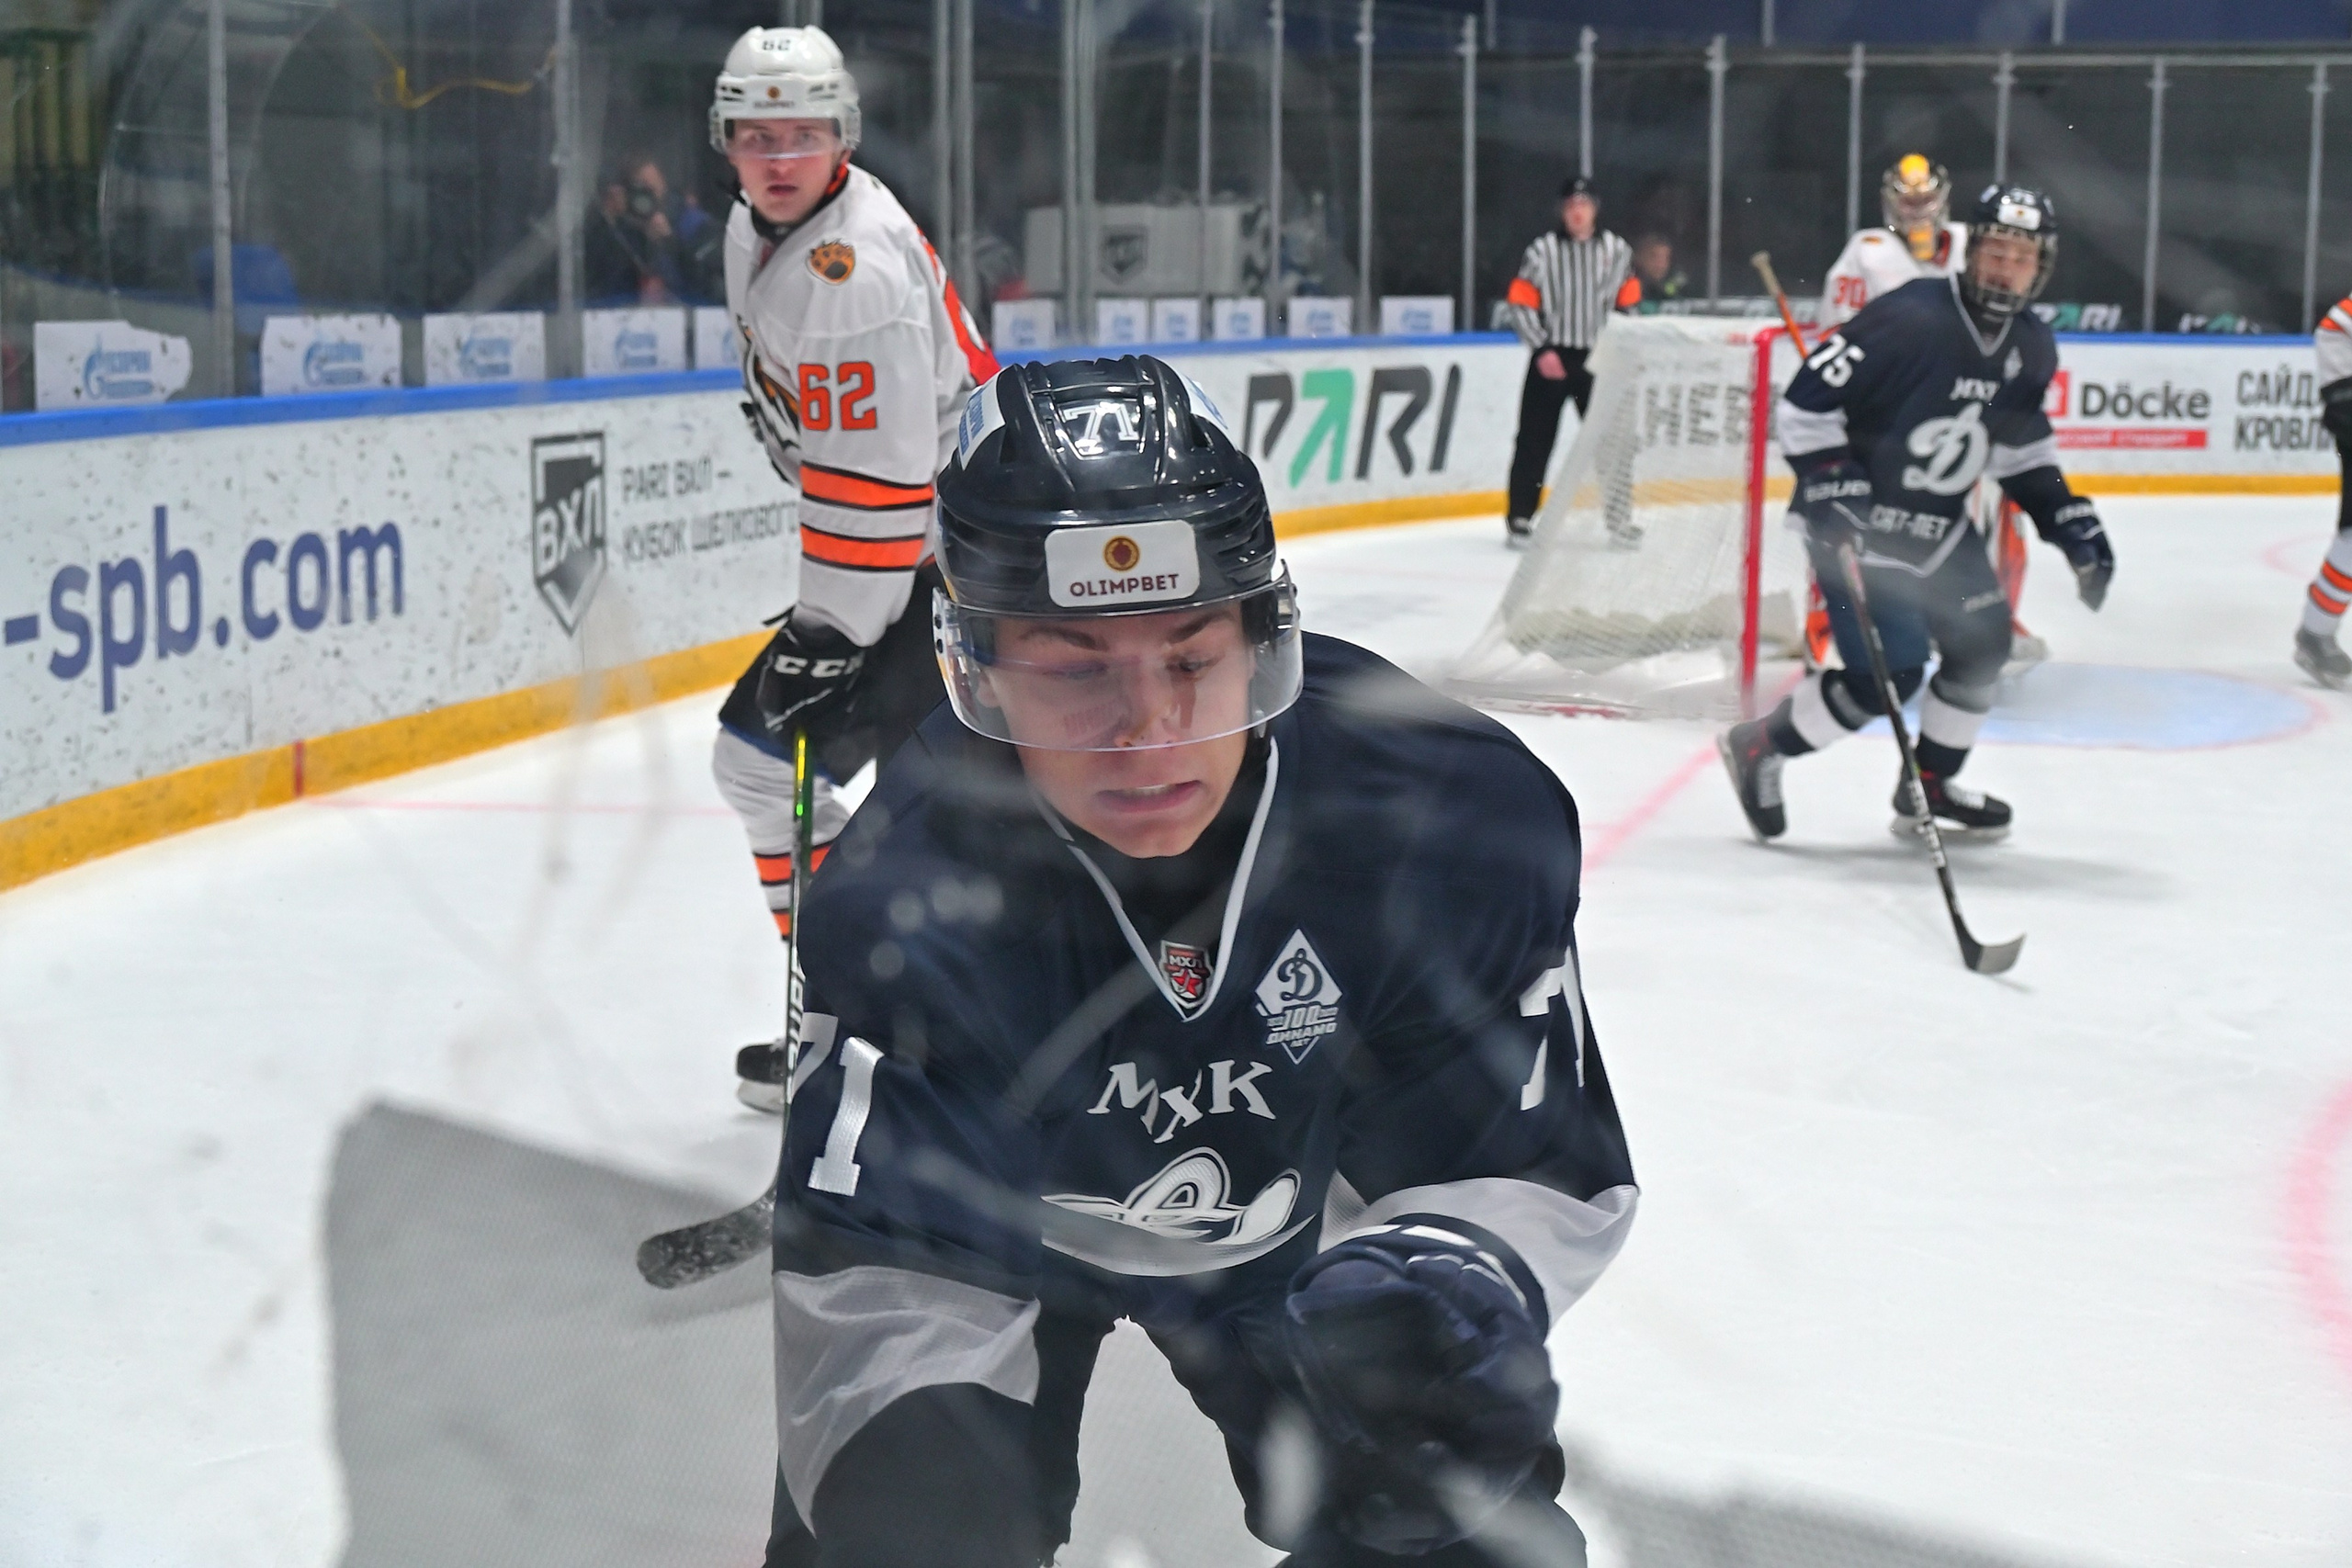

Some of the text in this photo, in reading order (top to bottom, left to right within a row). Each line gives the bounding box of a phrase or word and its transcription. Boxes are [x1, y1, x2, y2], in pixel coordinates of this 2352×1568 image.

[797, 361, 877, 431] 62
[2080, 379, 2211, 420] Döcke
[2237, 362, 2324, 407] САЙД
[1063, 401, 1139, 447] 71
[1243, 364, 1461, 488] PARI
[536, 474, 605, 577] ВХЛ
[4, 504, 404, 713] -spb.com
[1069, 573, 1180, 597] OLIMPBET
[1283, 1004, 1321, 1030] 100
[789, 1010, 885, 1197] 71
[1086, 1059, 1276, 1145] МХК
